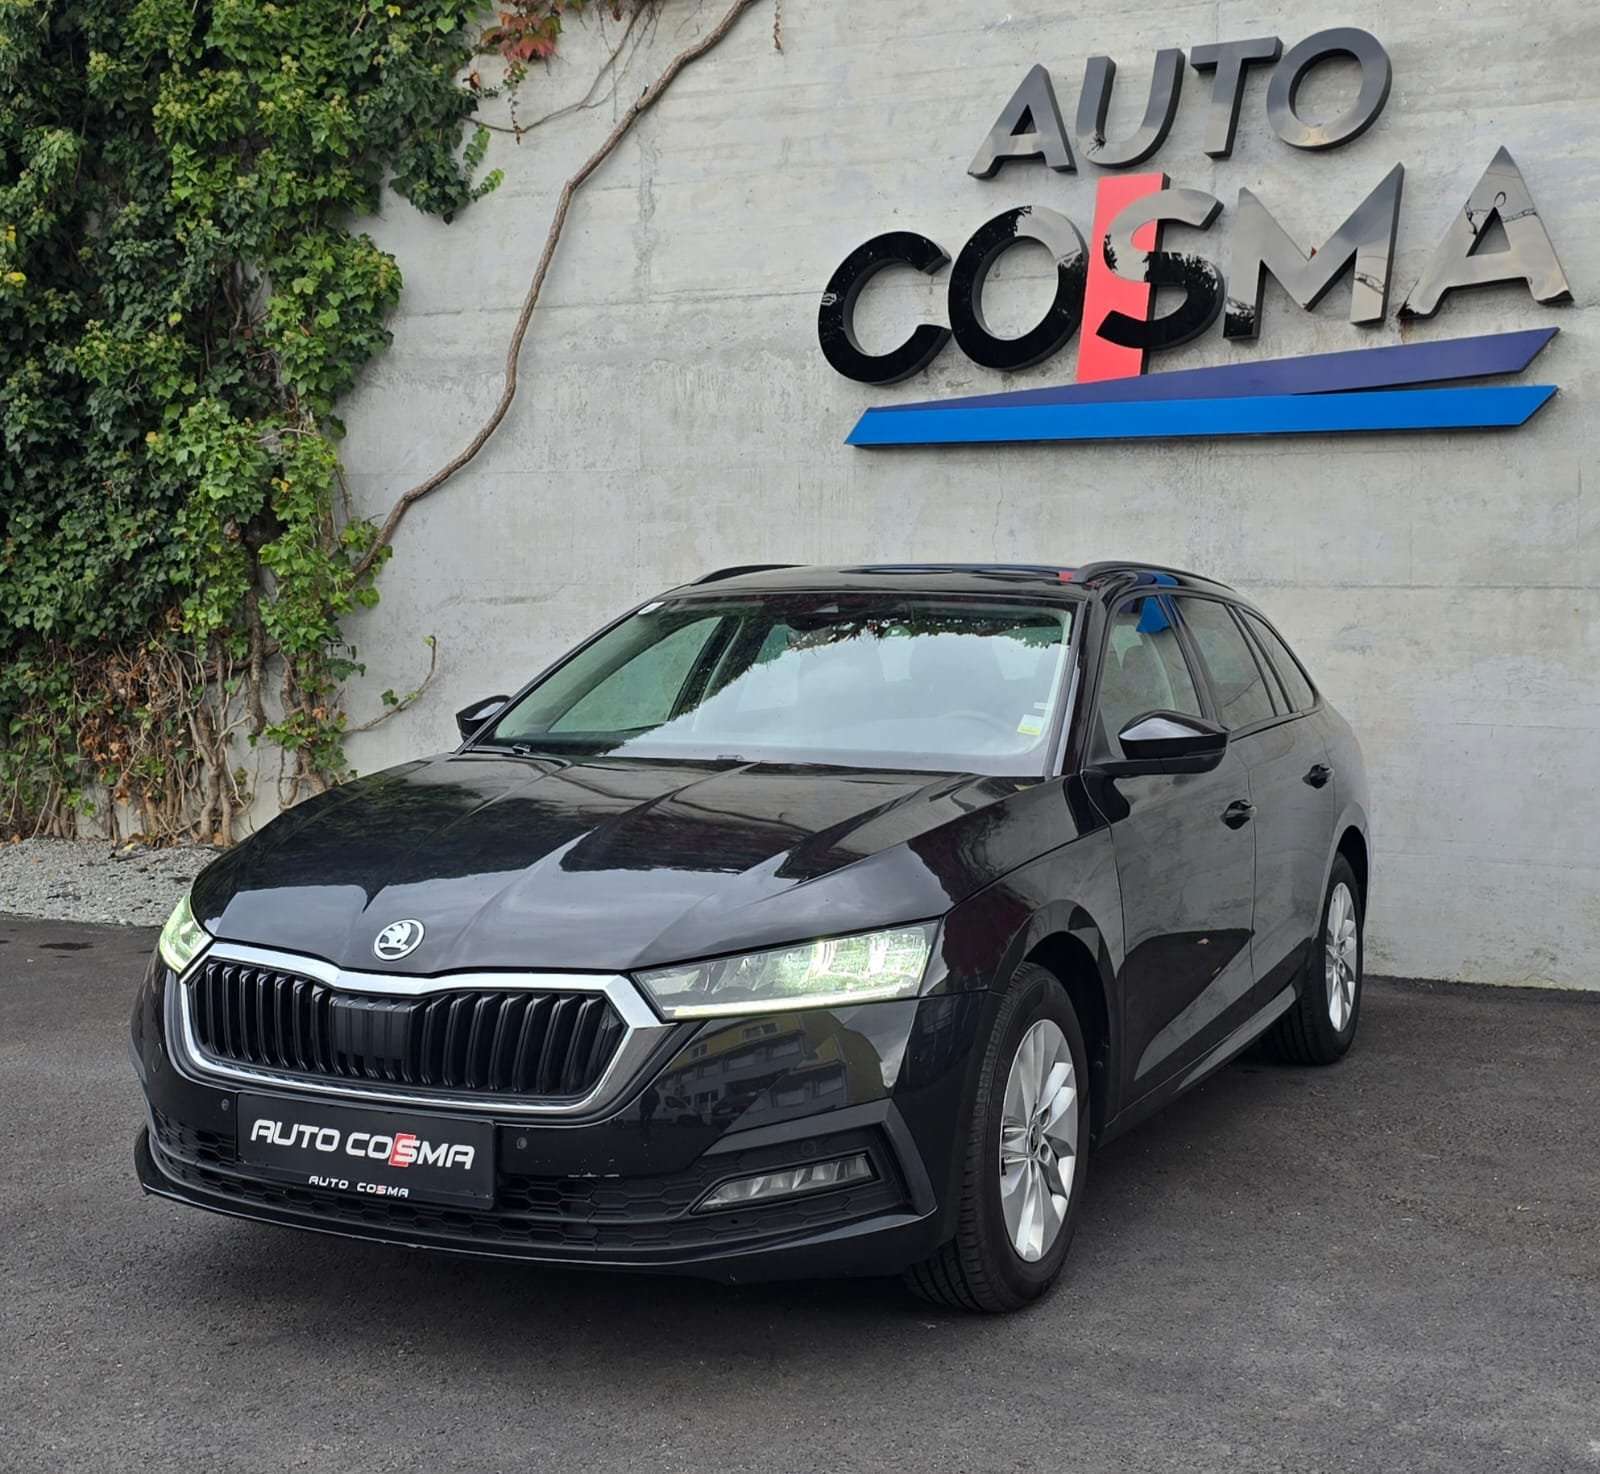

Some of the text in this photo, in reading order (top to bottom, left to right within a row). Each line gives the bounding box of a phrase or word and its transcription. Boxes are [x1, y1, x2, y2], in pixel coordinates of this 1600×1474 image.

[967, 27, 1392, 179] AUTO
[817, 145, 1575, 385] COSMA
[250, 1119, 475, 1170] AUTO COSMA
[308, 1175, 409, 1198] AUTO COSMA
